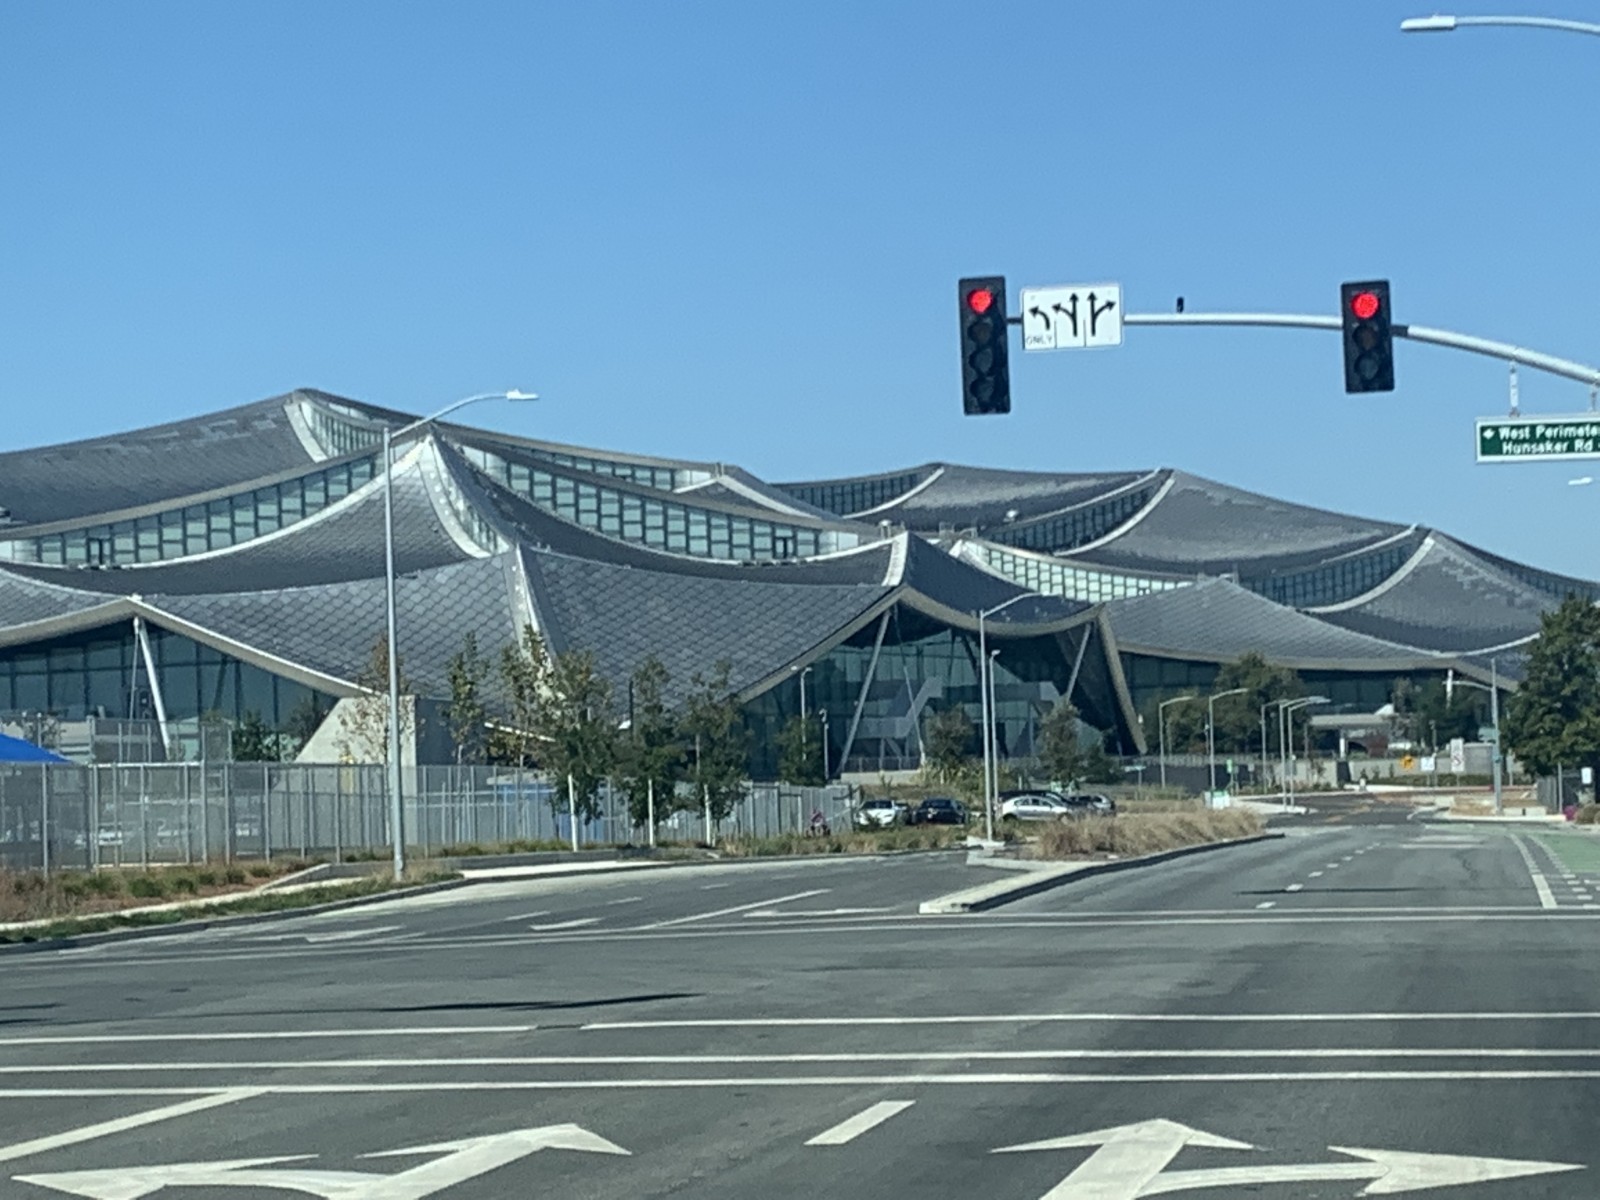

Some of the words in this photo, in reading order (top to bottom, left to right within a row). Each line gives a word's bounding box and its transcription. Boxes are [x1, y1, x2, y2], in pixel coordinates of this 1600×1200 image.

[1026, 335, 1053, 345] ONLY
[1499, 426, 1531, 440] West
[1502, 440, 1569, 454] Hunsaker
[1574, 438, 1593, 452] Rd
